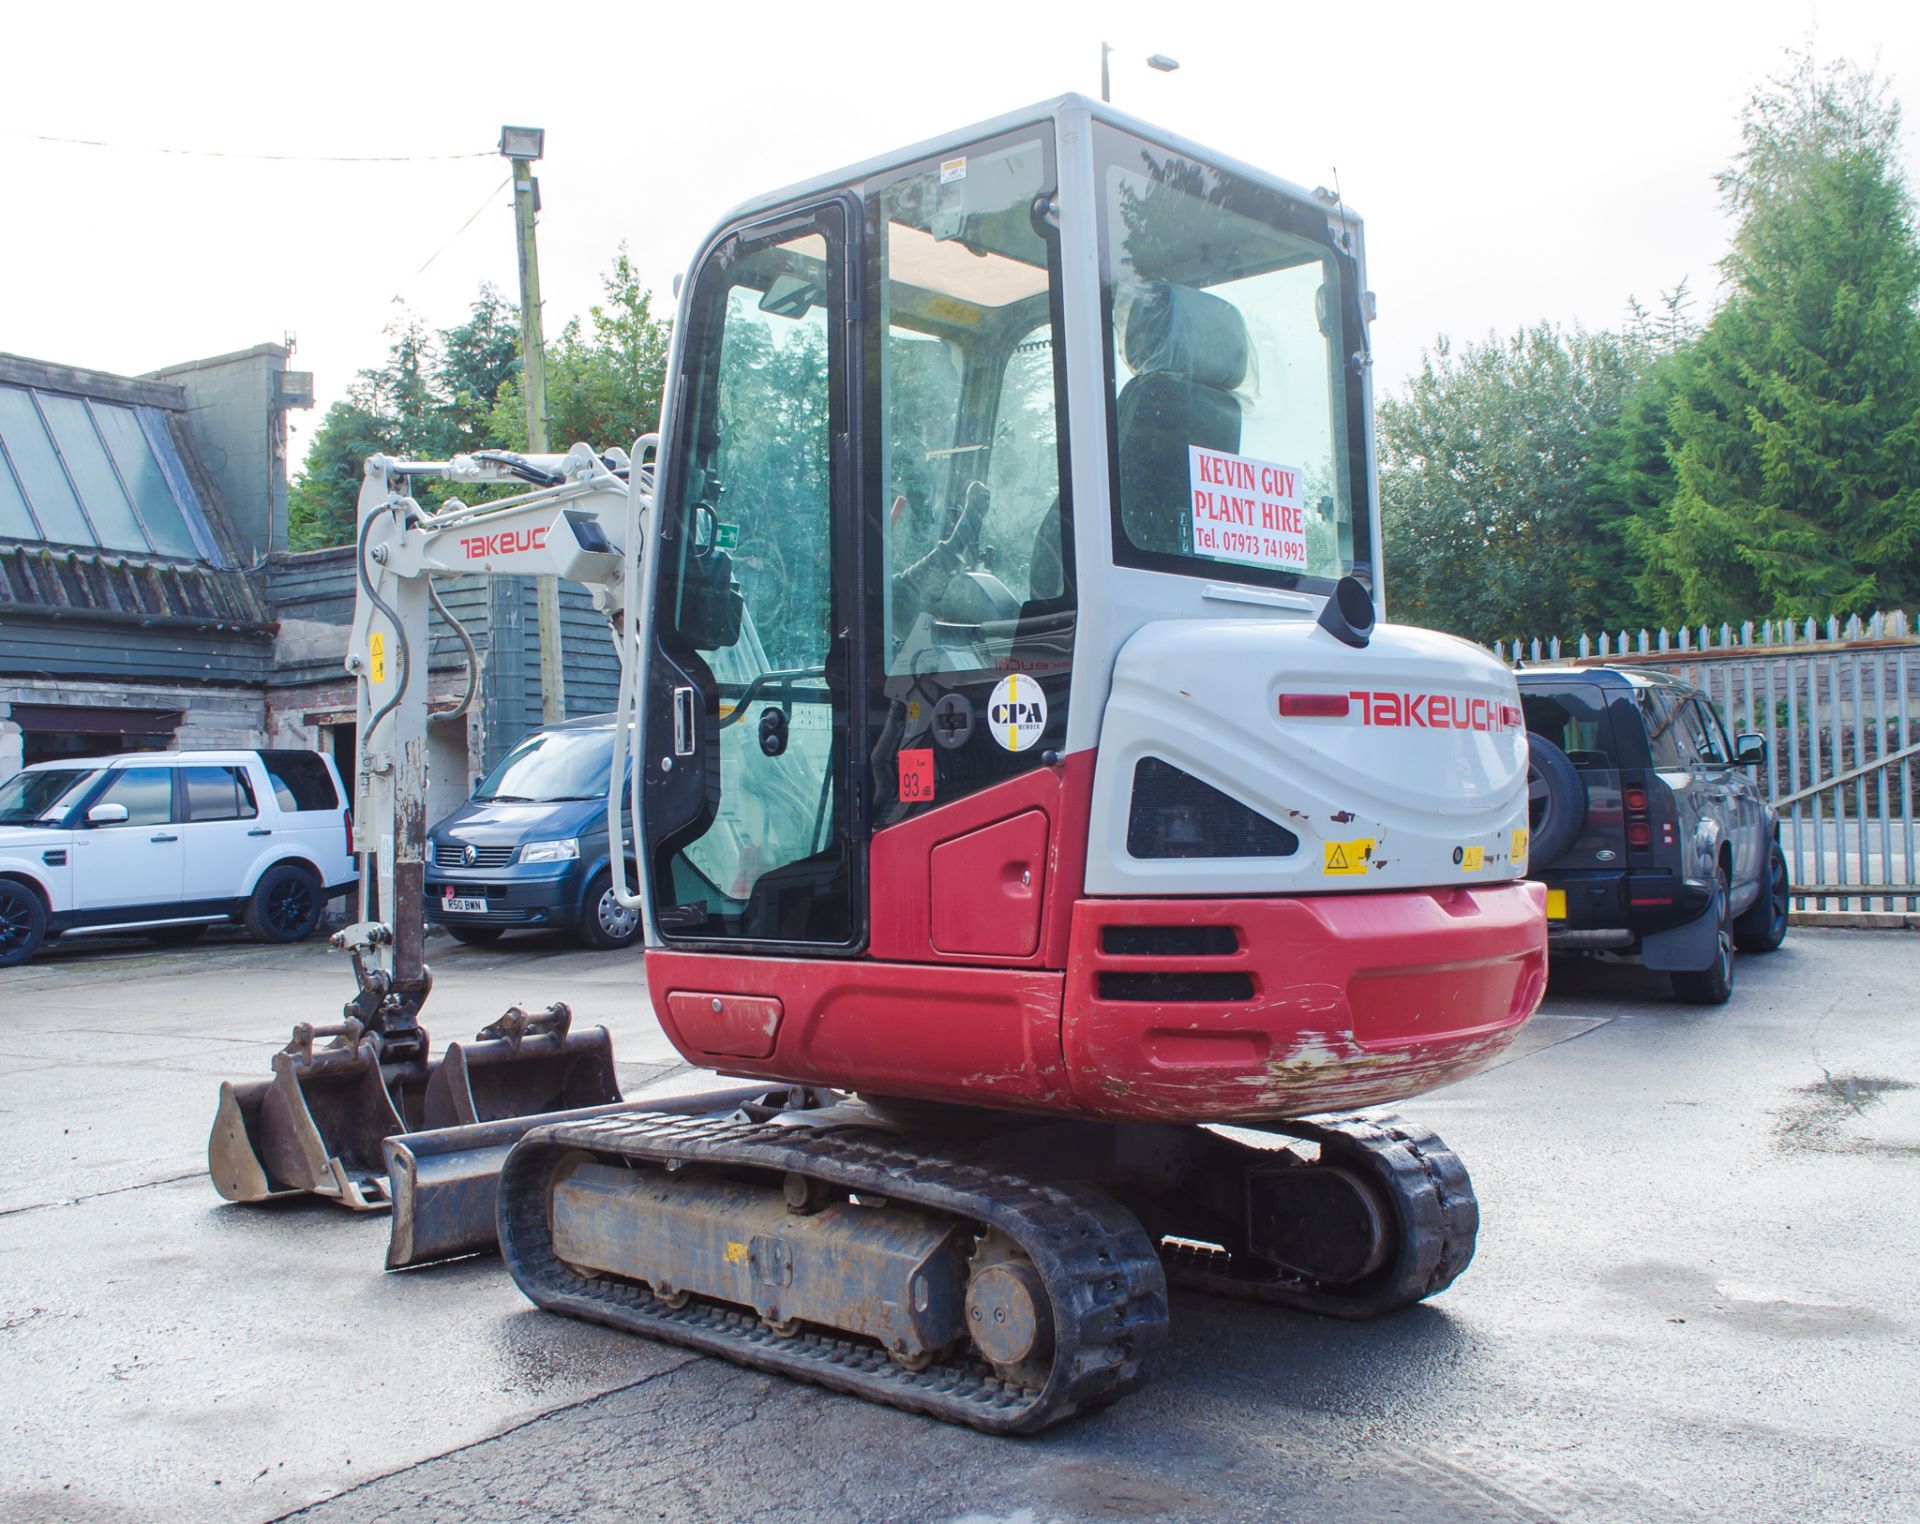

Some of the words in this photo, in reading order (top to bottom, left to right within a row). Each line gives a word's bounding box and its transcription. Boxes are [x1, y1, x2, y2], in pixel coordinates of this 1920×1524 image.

[1199, 454, 1256, 491] KEVIN
[1261, 467, 1295, 498] GUY
[1194, 490, 1256, 526] PLANT
[1261, 502, 1303, 534] HIRE
[460, 526, 550, 559] TAKEUC
[1223, 531, 1259, 556] 07973
[1264, 538, 1305, 561] 741992
[991, 702, 1043, 724] CPA
[1350, 691, 1503, 732] TAKEUCHI
[903, 773, 919, 797] 93
